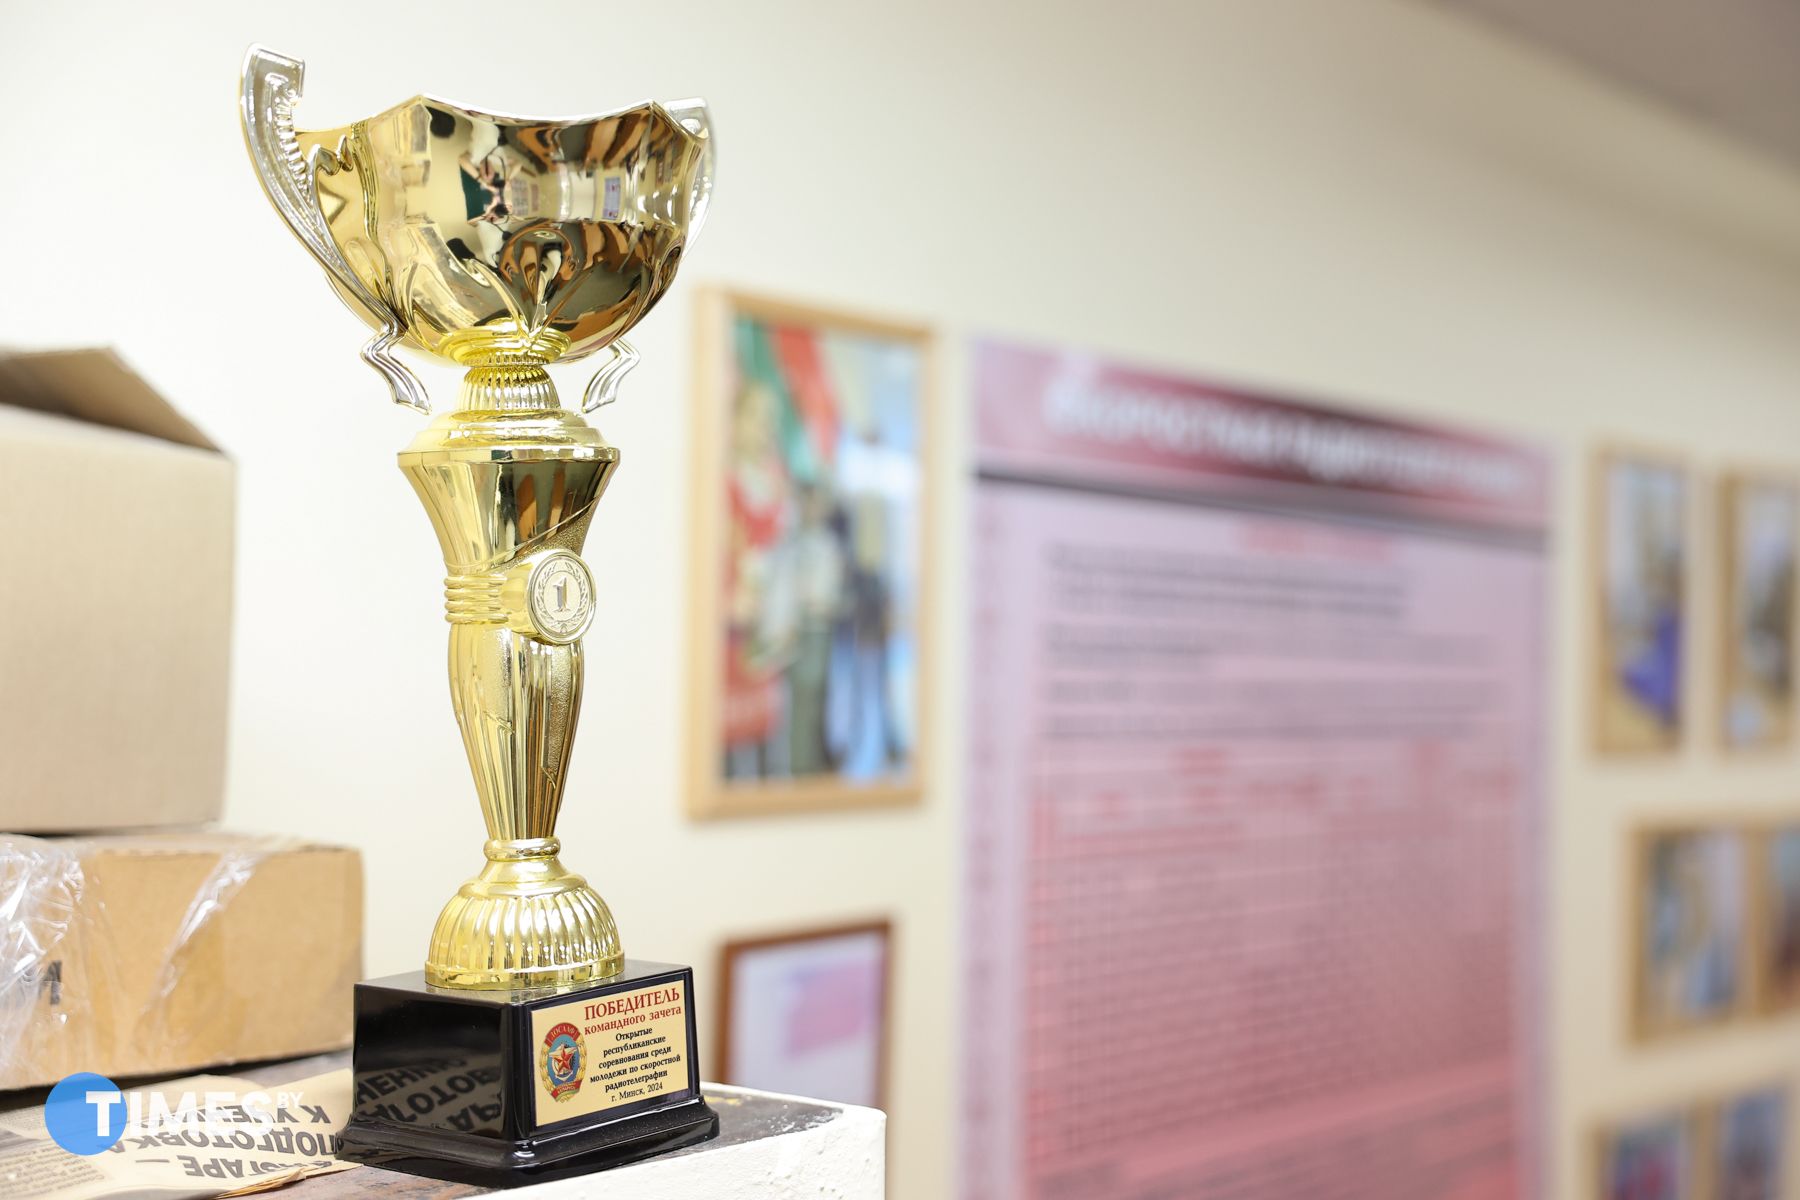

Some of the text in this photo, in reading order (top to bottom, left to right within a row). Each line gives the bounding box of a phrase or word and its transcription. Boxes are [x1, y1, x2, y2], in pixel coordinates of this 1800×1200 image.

[553, 576, 570, 612] 1
[584, 987, 680, 1020] ПОБЕДИТЕЛЬ
[584, 1005, 681, 1035] командного зачета
[615, 1027, 653, 1042] Открытые
[598, 1046, 672, 1069] соревнования среди
[603, 1036, 666, 1057] республиканские
[590, 1054, 681, 1084] молодежи по скоростной
[605, 1069, 668, 1093] радиотелеграфии
[619, 1087, 646, 1101] Минск,
[647, 1083, 663, 1093] 2024
[302, 1105, 331, 1124] К
